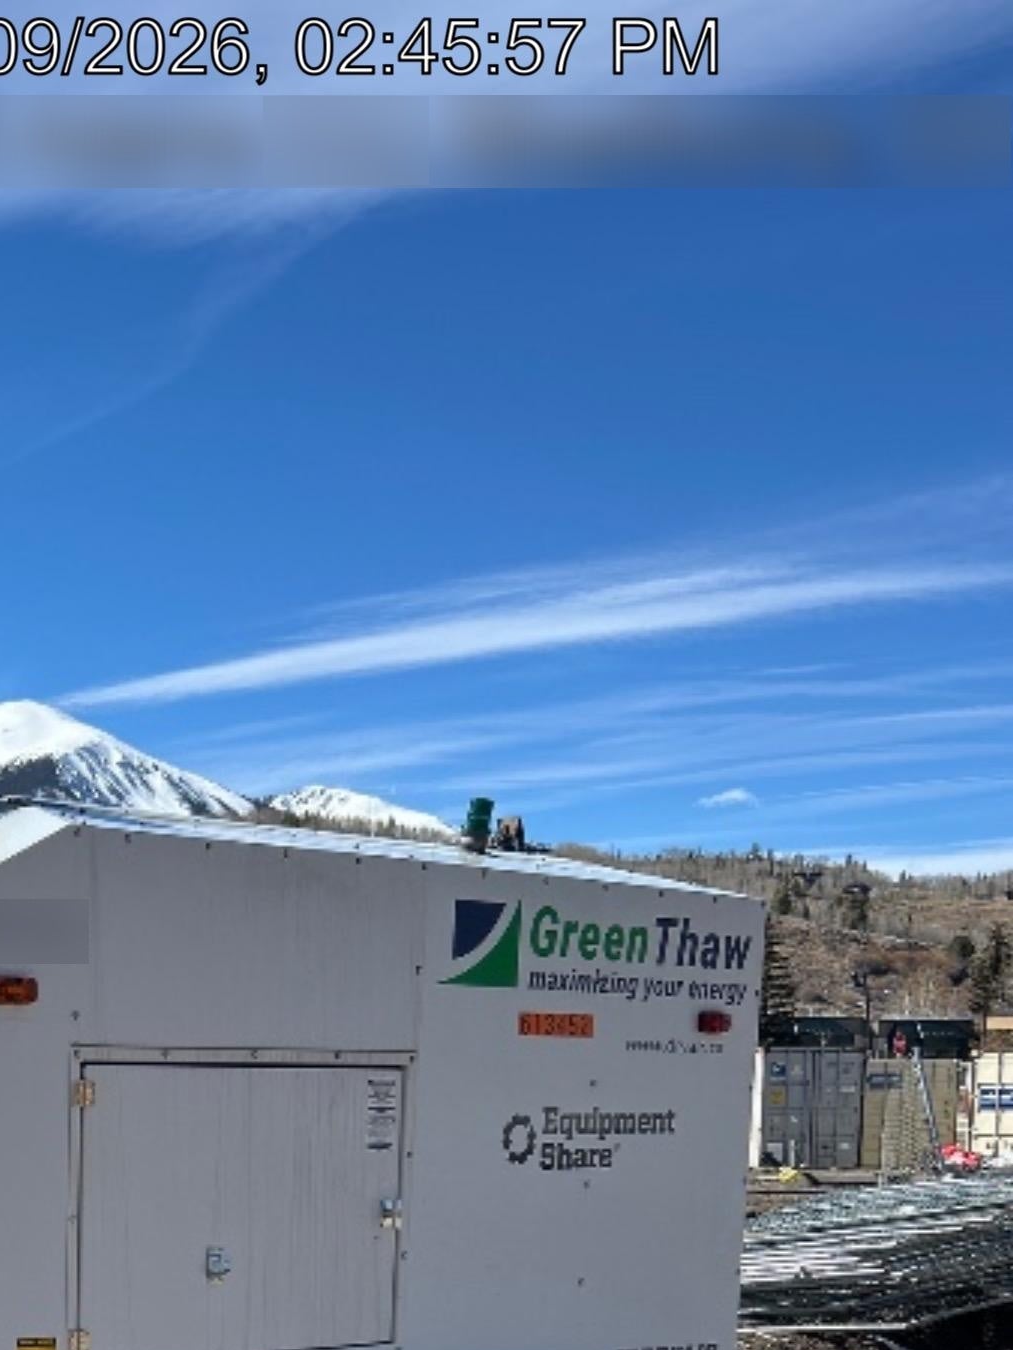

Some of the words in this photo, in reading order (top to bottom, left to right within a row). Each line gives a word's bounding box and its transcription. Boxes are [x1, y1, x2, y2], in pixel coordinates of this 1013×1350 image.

[527, 968, 639, 999] maximizing
[643, 976, 684, 1002] your
[689, 980, 747, 1005] energy
[542, 1106, 676, 1140] Equipment
[540, 1142, 613, 1171] Share
